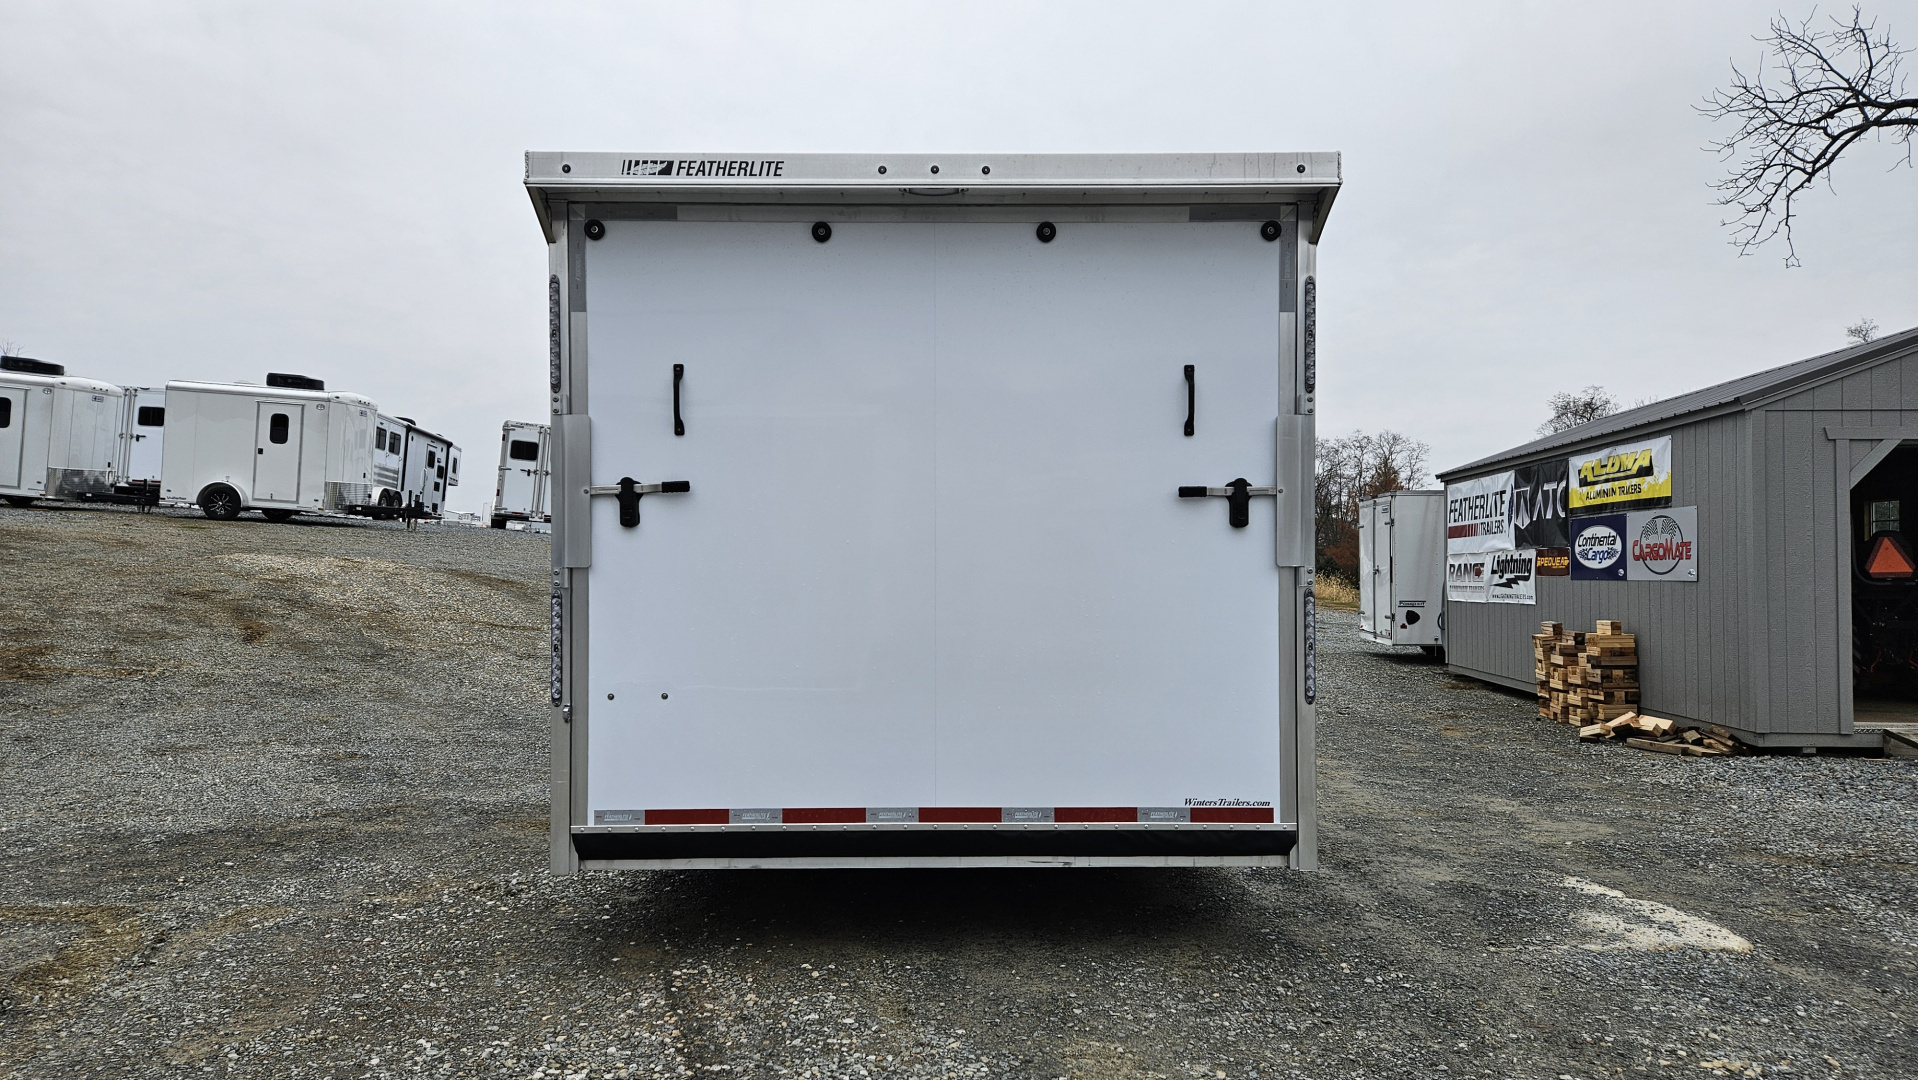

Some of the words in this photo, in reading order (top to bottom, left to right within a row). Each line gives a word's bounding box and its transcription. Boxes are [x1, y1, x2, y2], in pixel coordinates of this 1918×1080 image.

[676, 160, 784, 176] FEATHERLITE
[1580, 448, 1653, 482] ALUMA
[1448, 489, 1507, 524] FEATHERLITE
[1480, 519, 1504, 536] TRAILERS
[1577, 531, 1618, 548] Continental
[1586, 547, 1609, 564] Cargo
[1490, 552, 1533, 580] Lightning
[1184, 798, 1271, 807] WintersTrailers.com
